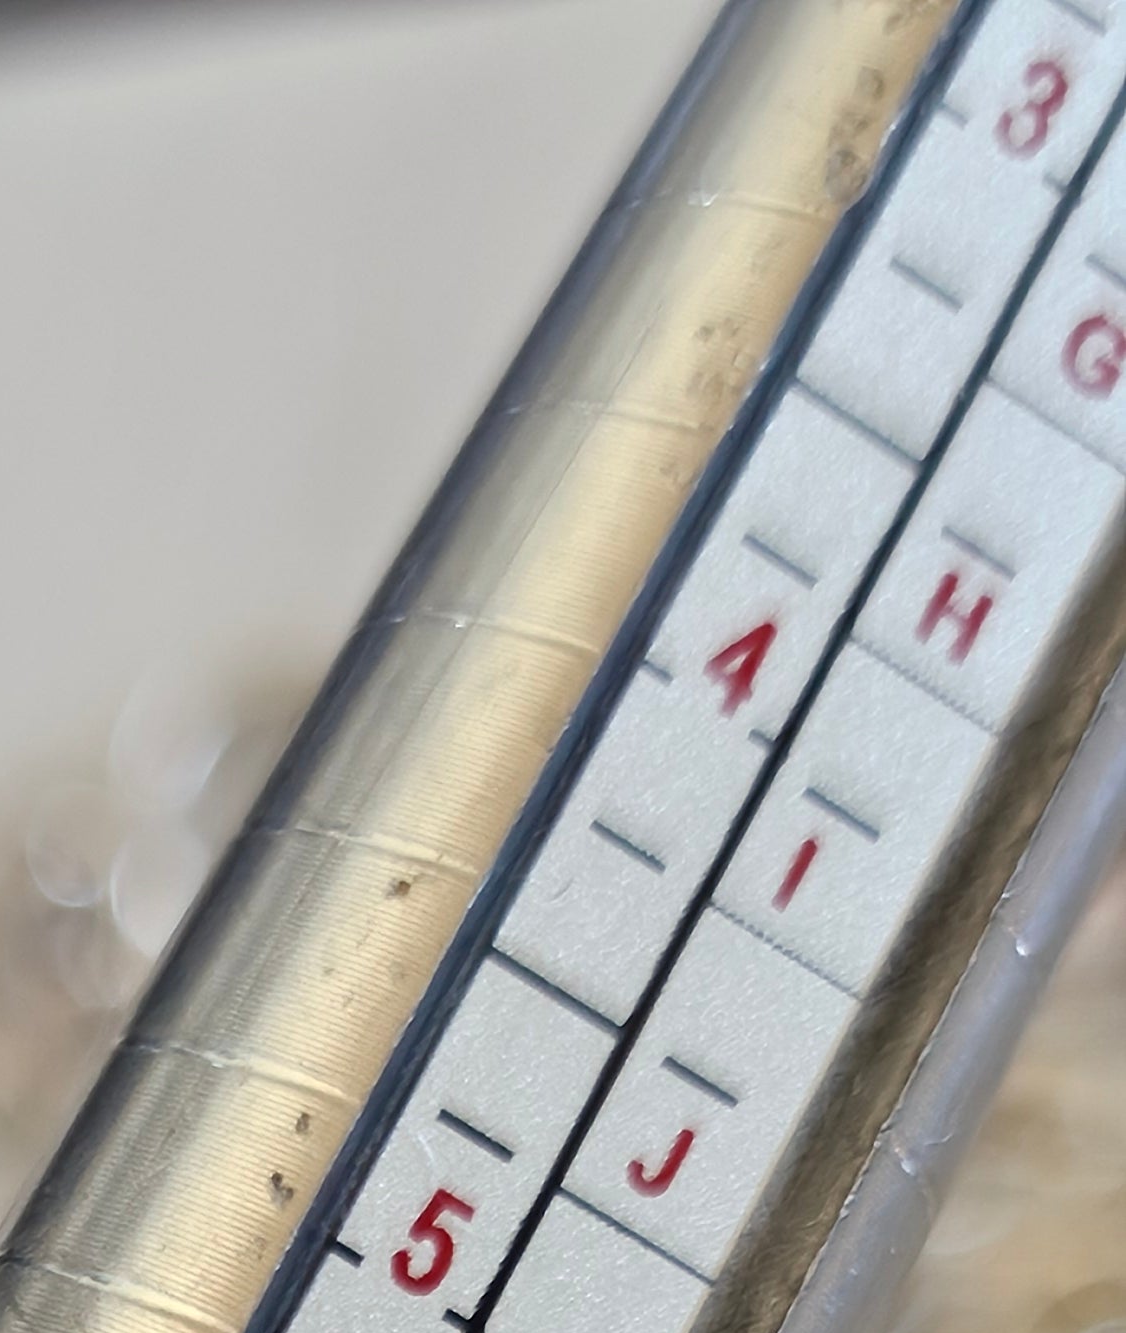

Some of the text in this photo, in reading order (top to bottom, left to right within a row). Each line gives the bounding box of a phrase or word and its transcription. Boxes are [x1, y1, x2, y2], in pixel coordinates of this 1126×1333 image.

[994, 60, 1068, 158] 3
[1060, 313, 1126, 399] G
[916, 571, 995, 666] H
[705, 622, 778, 717] 4
[774, 838, 819, 910] I
[628, 1128, 696, 1195] J
[392, 1187, 472, 1293] 5
